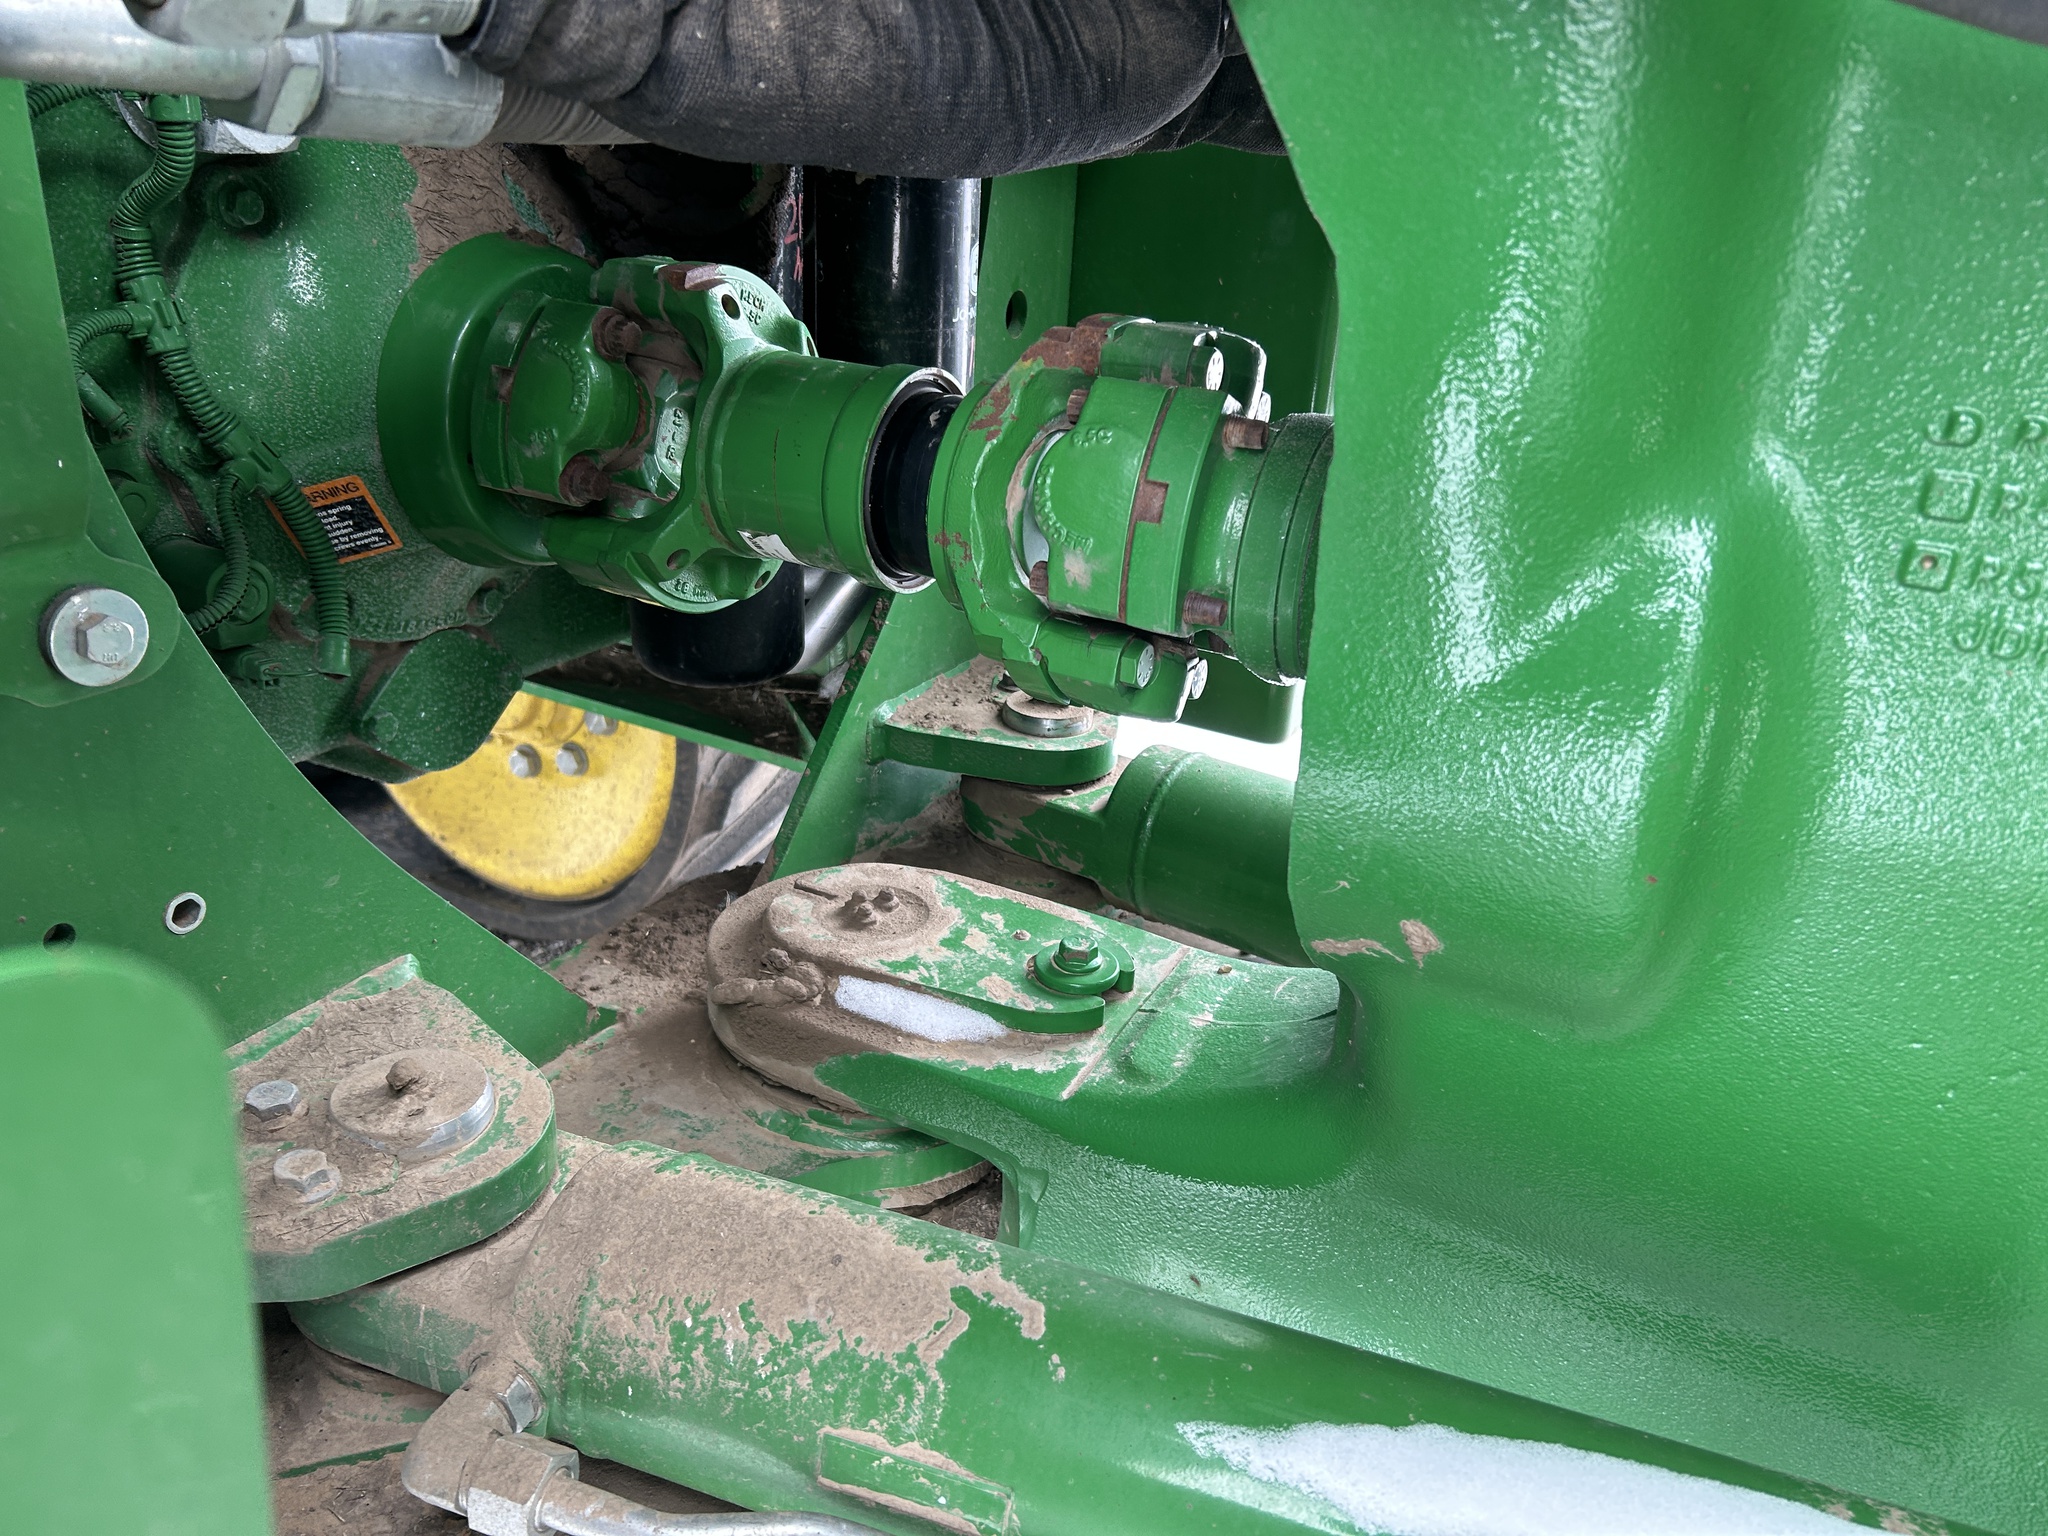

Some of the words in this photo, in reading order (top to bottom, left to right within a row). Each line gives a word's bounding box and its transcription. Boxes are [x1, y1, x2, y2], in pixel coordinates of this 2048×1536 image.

[306, 482, 359, 502] RNING
[328, 505, 352, 514] spring
[350, 528, 384, 539] removing
